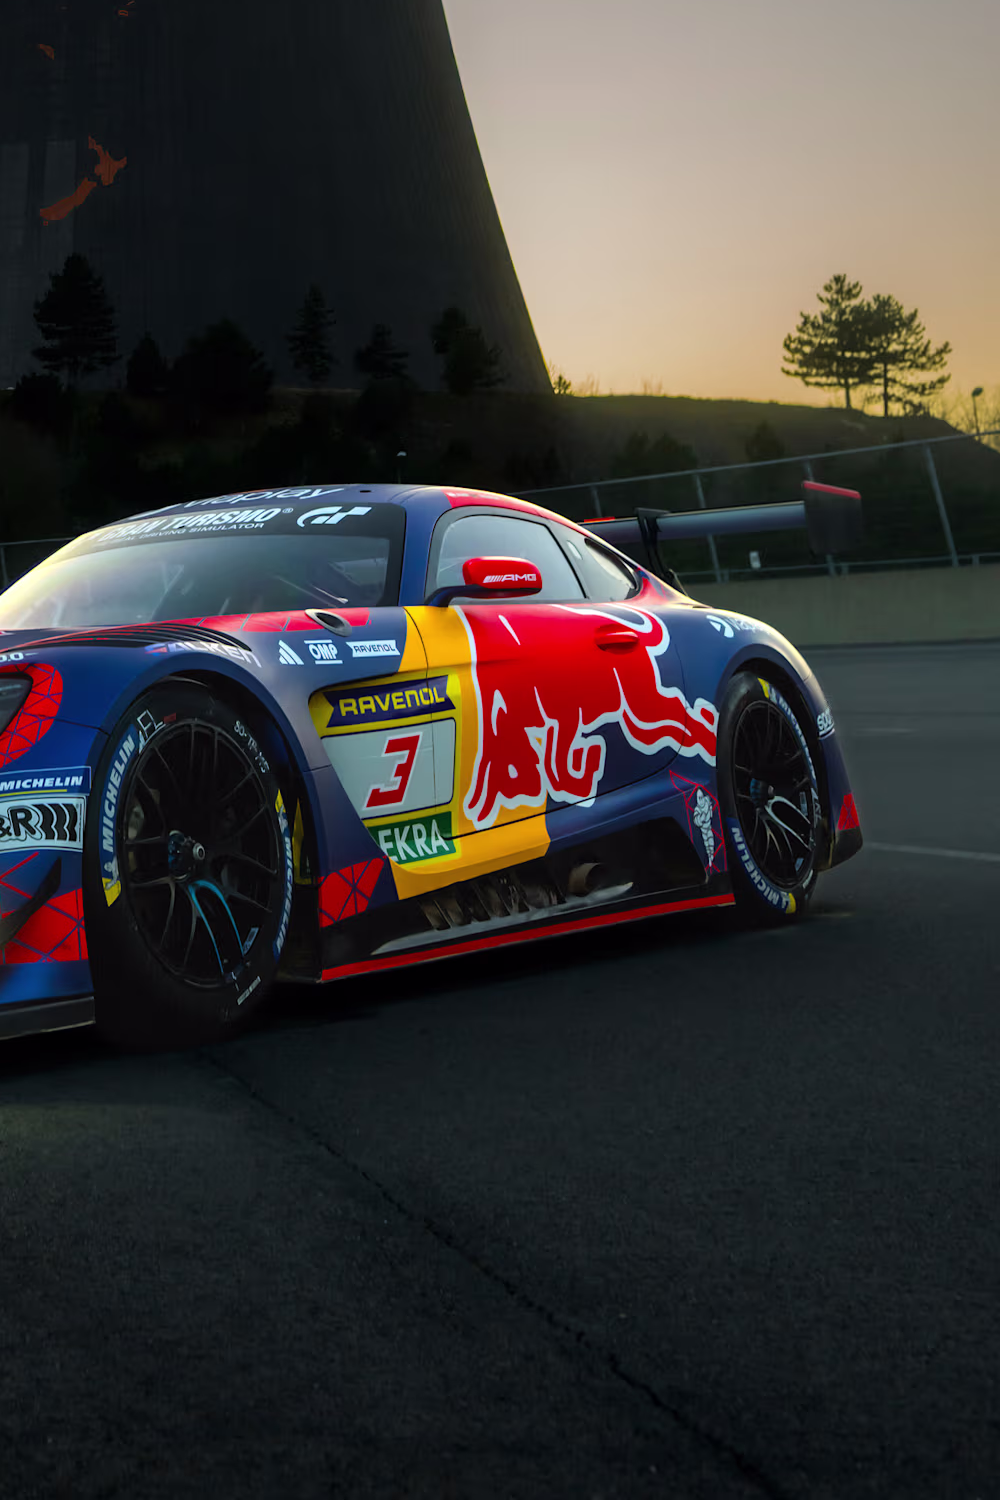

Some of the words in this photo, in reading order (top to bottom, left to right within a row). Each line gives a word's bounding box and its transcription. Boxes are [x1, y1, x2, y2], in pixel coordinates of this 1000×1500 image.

[184, 487, 345, 508] viaplay
[98, 519, 167, 542] GRAN
[189, 522, 265, 534] SIMULATOR
[501, 573, 537, 583] AMG
[308, 643, 339, 660] OMP
[353, 643, 396, 653] RAVENOL
[338, 686, 445, 717] RAVENOL
[362, 731, 424, 811] 3
[0, 774, 84, 791] MICHELIN
[102, 734, 136, 853] MICHELIN
[377, 818, 450, 863] EKRA
[731, 827, 780, 905] MICHELIN
